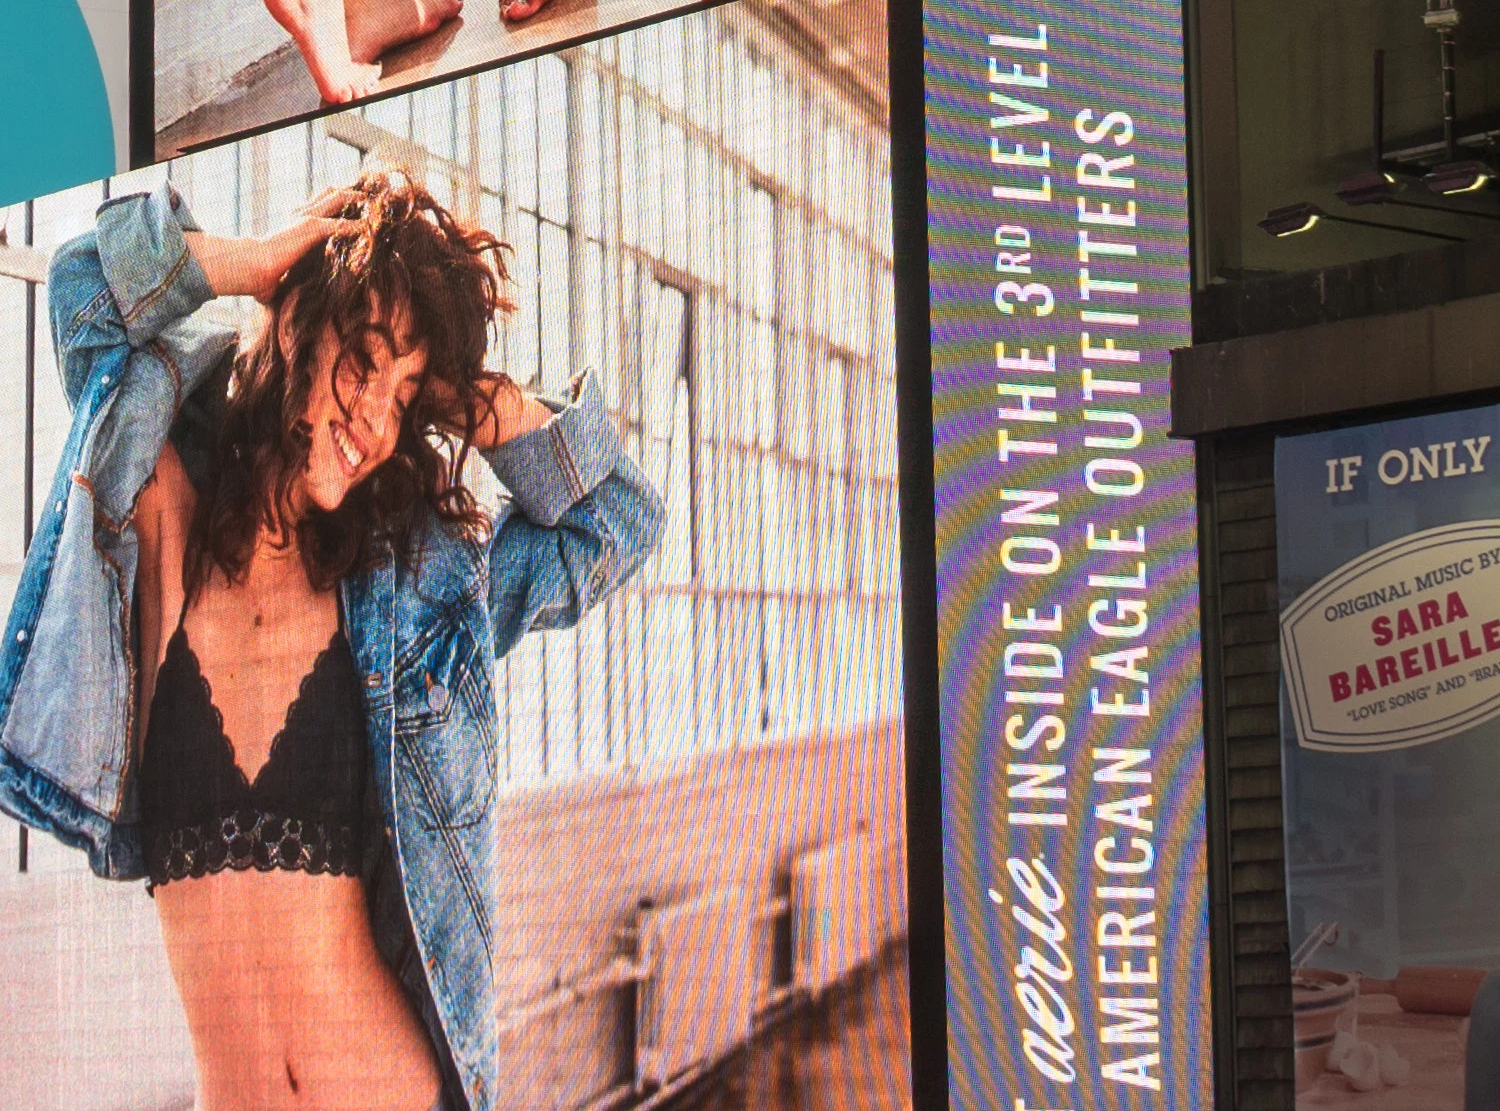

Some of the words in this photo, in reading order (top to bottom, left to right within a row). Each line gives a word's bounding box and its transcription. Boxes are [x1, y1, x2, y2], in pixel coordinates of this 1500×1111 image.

[988, 24, 1051, 201] LEVEL
[994, 225, 1054, 316] 3RD
[1073, 108, 1146, 500] OUTFITTERS
[997, 341, 1058, 463] THE
[1325, 456, 1361, 495] IF
[1377, 434, 1487, 487] ONLY
[1002, 488, 1061, 577] ON
[1324, 581, 1412, 622] ORIGINAL
[1415, 558, 1474, 592] MUSIC
[1087, 525, 1151, 717] EAGLE
[1371, 591, 1469, 646] SARA
[1005, 600, 1068, 826] INSIDE
[1436, 674, 1466, 696] AND
[988, 857, 1076, 1083] aerie
[1094, 747, 1161, 1091] AMERICAN
